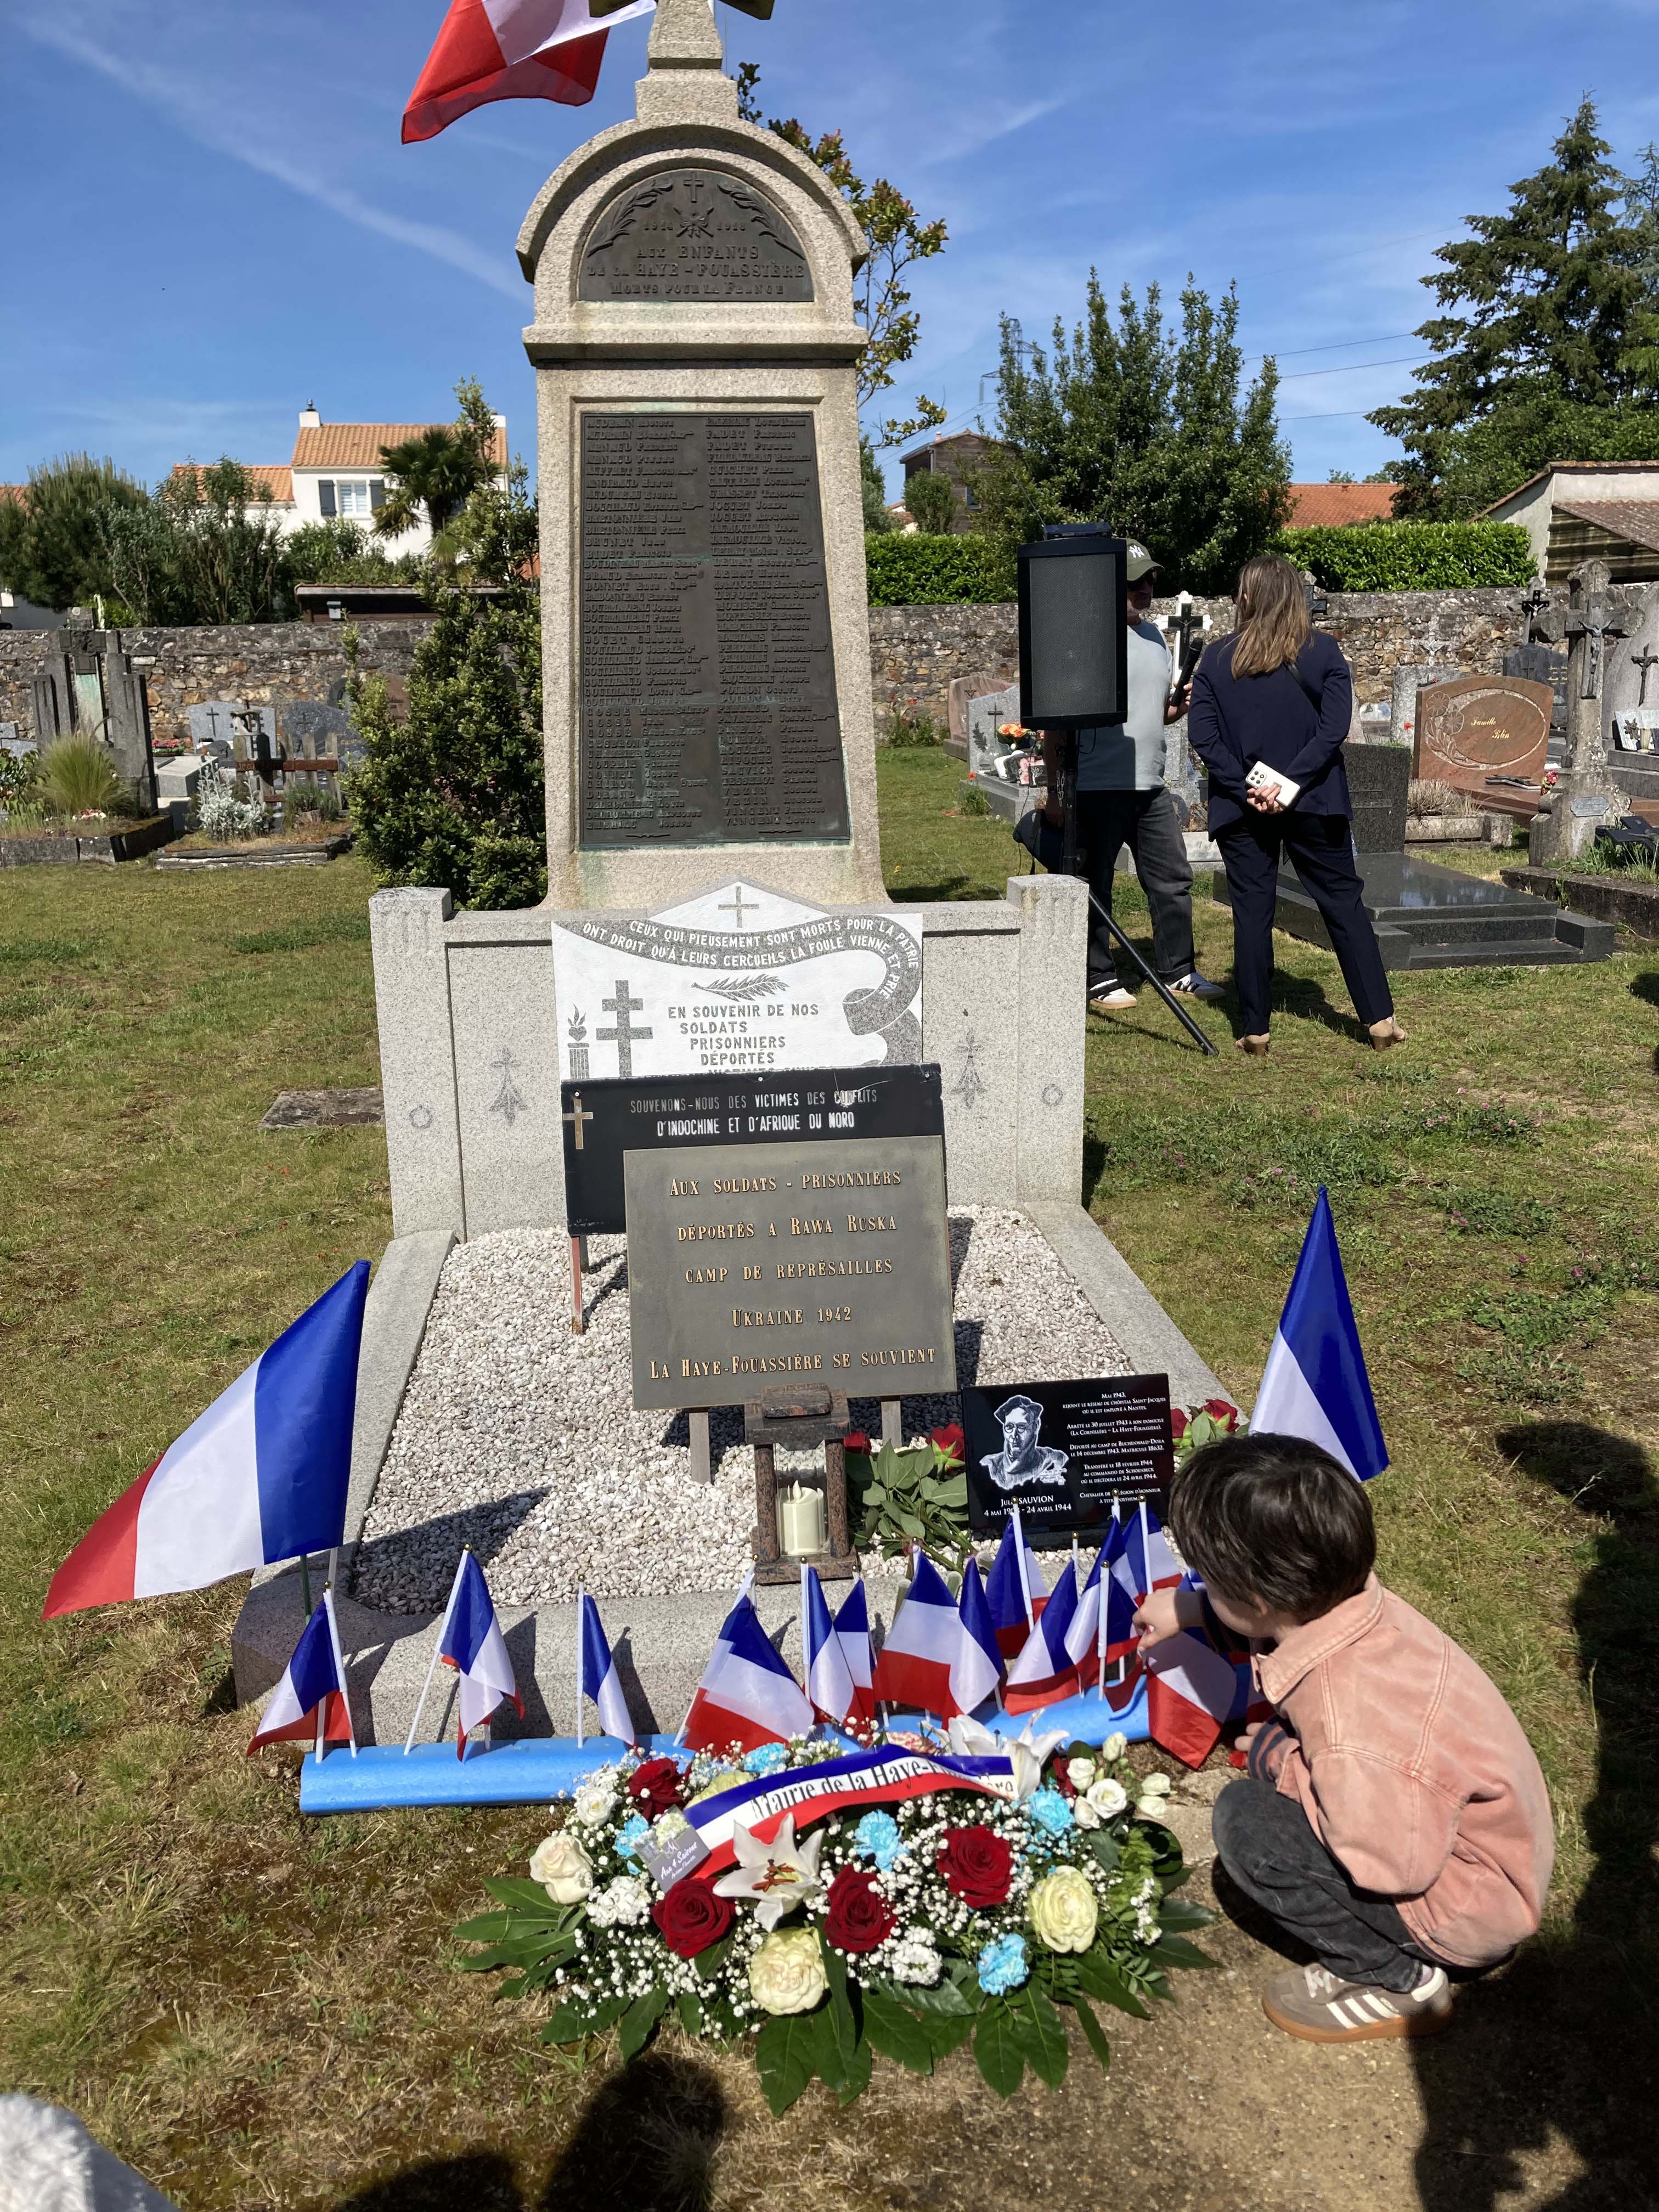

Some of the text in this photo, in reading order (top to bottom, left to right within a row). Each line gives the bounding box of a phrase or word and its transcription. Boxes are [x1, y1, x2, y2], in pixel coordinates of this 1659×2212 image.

[644, 222, 674, 232] 1914
[716, 221, 746, 231] 1918
[637, 246, 759, 259] AUX ENFANTS
[588, 267, 606, 276] DE
[612, 267, 629, 276] LA
[611, 282, 785, 295] MORTS POUR LA FRANCE
[1471, 716, 1497, 726] Famille
[1492, 729, 1510, 739] Blin
[583, 922, 607, 940] ONT
[610, 932, 647, 955] DROIT
[630, 918, 919, 970] CEUX QUI PIEUSEMENT SONT MORTS POUR LA PATRIE
[809, 935, 845, 955] FOULE
[850, 933, 890, 952] VIENNE
[681, 950, 718, 967] LEURS
[723, 952, 787, 968] CERCUEILS
[791, 945, 807, 961] LA
[885, 952, 901, 970] ET
[880, 972, 900, 1001] PRIE
[668, 1003, 820, 1019] EN SOUVENIR DE NOS
[680, 1020, 748, 1034] SOLDATS
[690, 1035, 786, 1050] PRISONNIERS
[700, 1051, 775, 1066] DÉPORTÉS
[630, 1088, 878, 1114] SOUVENONS-NOUS DES VICTIMES DES CONFLITS
[657, 1111, 856, 1137] D'INDOCHINE ET D'AFRIQUE DU NORD
[669, 1176, 700, 1197] AUX
[713, 1175, 777, 1195] SOLDATS
[801, 1170, 902, 1190] PRISONNIERS
[677, 1214, 898, 1242] DÉPORTÉS A RAWA RUSKA
[685, 1258, 894, 1284] CAMP DE REPRÉSAILLES
[731, 1306, 852, 1328] UKRAINE 1942
[650, 1360, 670, 1380] LA
[833, 1353, 851, 1369] SE
[861, 1347, 936, 1367] SOUVIENT
[1000, 1495, 1054, 1508] JUL SAUVION
[1055, 1503, 1072, 1511] 1944
[750, 1780, 817, 1821] Mairie
[820, 1771, 844, 1796] de
[849, 1769, 869, 1793] la
[661, 1866, 673, 1880] Aux
[677, 1841, 698, 1864] Saisons
